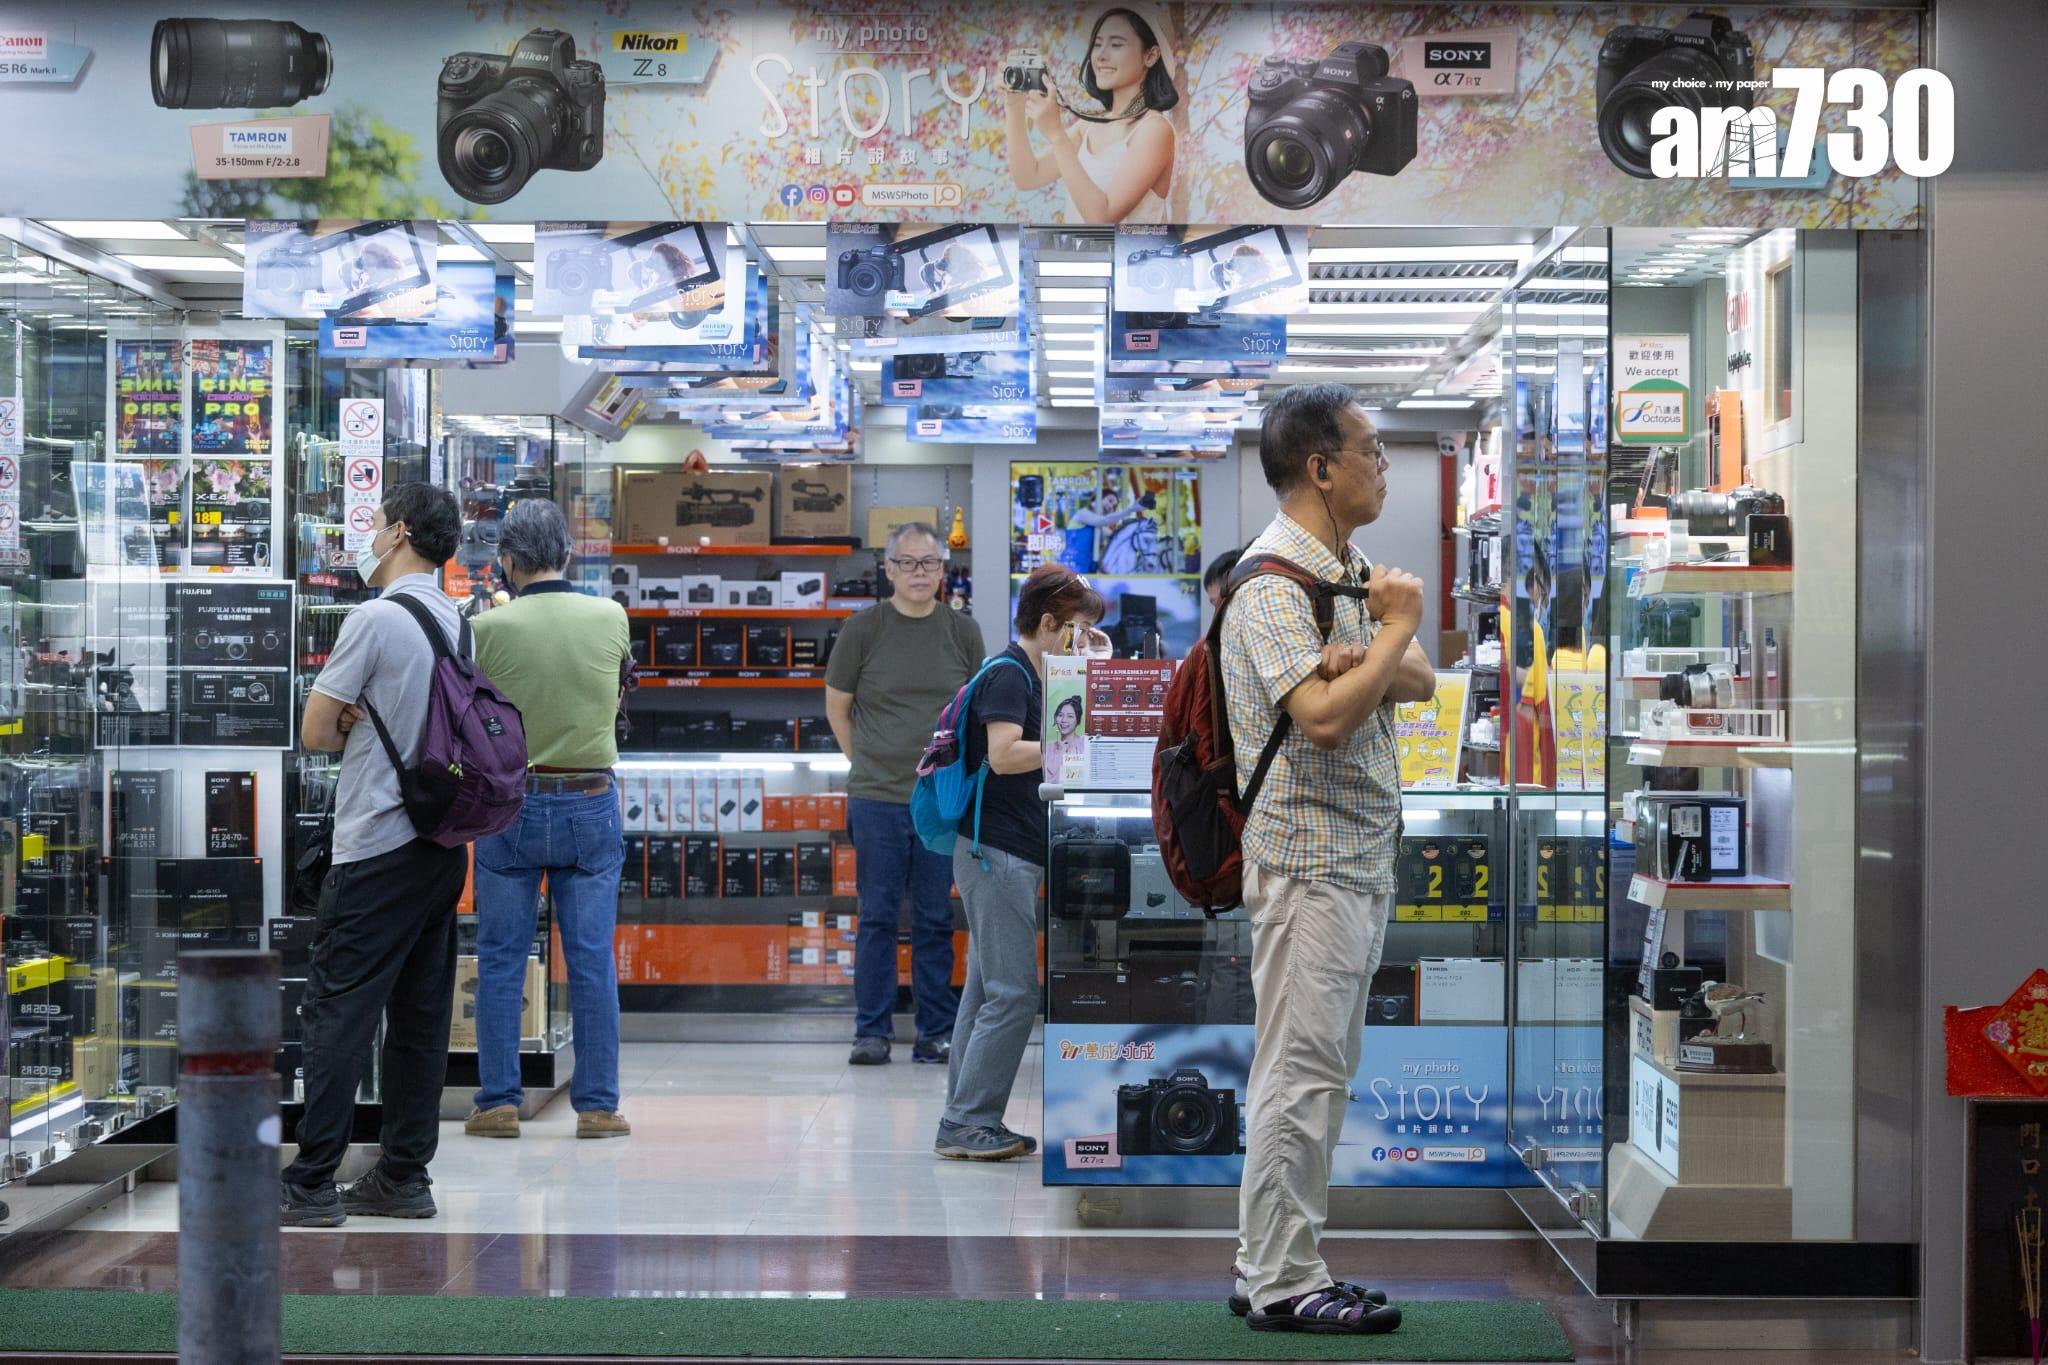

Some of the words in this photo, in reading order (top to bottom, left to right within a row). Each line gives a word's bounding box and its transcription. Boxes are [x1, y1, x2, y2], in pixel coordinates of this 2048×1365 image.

[815, 25, 849, 48] my
[860, 19, 929, 47] photo
[621, 34, 679, 51] Nikon
[517, 51, 550, 62] Nikon
[1429, 50, 1486, 61] SONY
[11, 63, 28, 74] R6
[657, 63, 667, 77] 8
[1322, 66, 1352, 77] SONY
[750, 52, 988, 139] Story
[229, 133, 287, 142] TAMRON
[215, 157, 264, 167] 35-150mm
[266, 157, 300, 167] F/2-2.8
[805, 148, 950, 165] 相片說故事
[872, 191, 929, 200] MSWSPhoto
[449, 334, 488, 349] Story
[1241, 336, 1281, 351] Story
[1629, 350, 1674, 361] 歡迎使用
[1625, 366, 1642, 377] We
[1645, 367, 1679, 378] accept
[204, 402, 260, 416] PRO
[1655, 405, 1681, 415] 八達通
[1642, 413, 1681, 425] Octopus
[667, 546, 702, 554] SONY
[182, 588, 212, 596] FUJIFILM
[668, 608, 702, 617] SONY
[666, 678, 701, 687] SONY
[1427, 865, 1443, 898] 2
[1472, 865, 1489, 898] 2
[1403, 1063, 1421, 1075] my
[1424, 1060, 1460, 1075] photo
[1369, 1077, 1489, 1121] Story
[1397, 1124, 1470, 1134] 相片說故事
[1077, 1144, 1107, 1152] SONY
